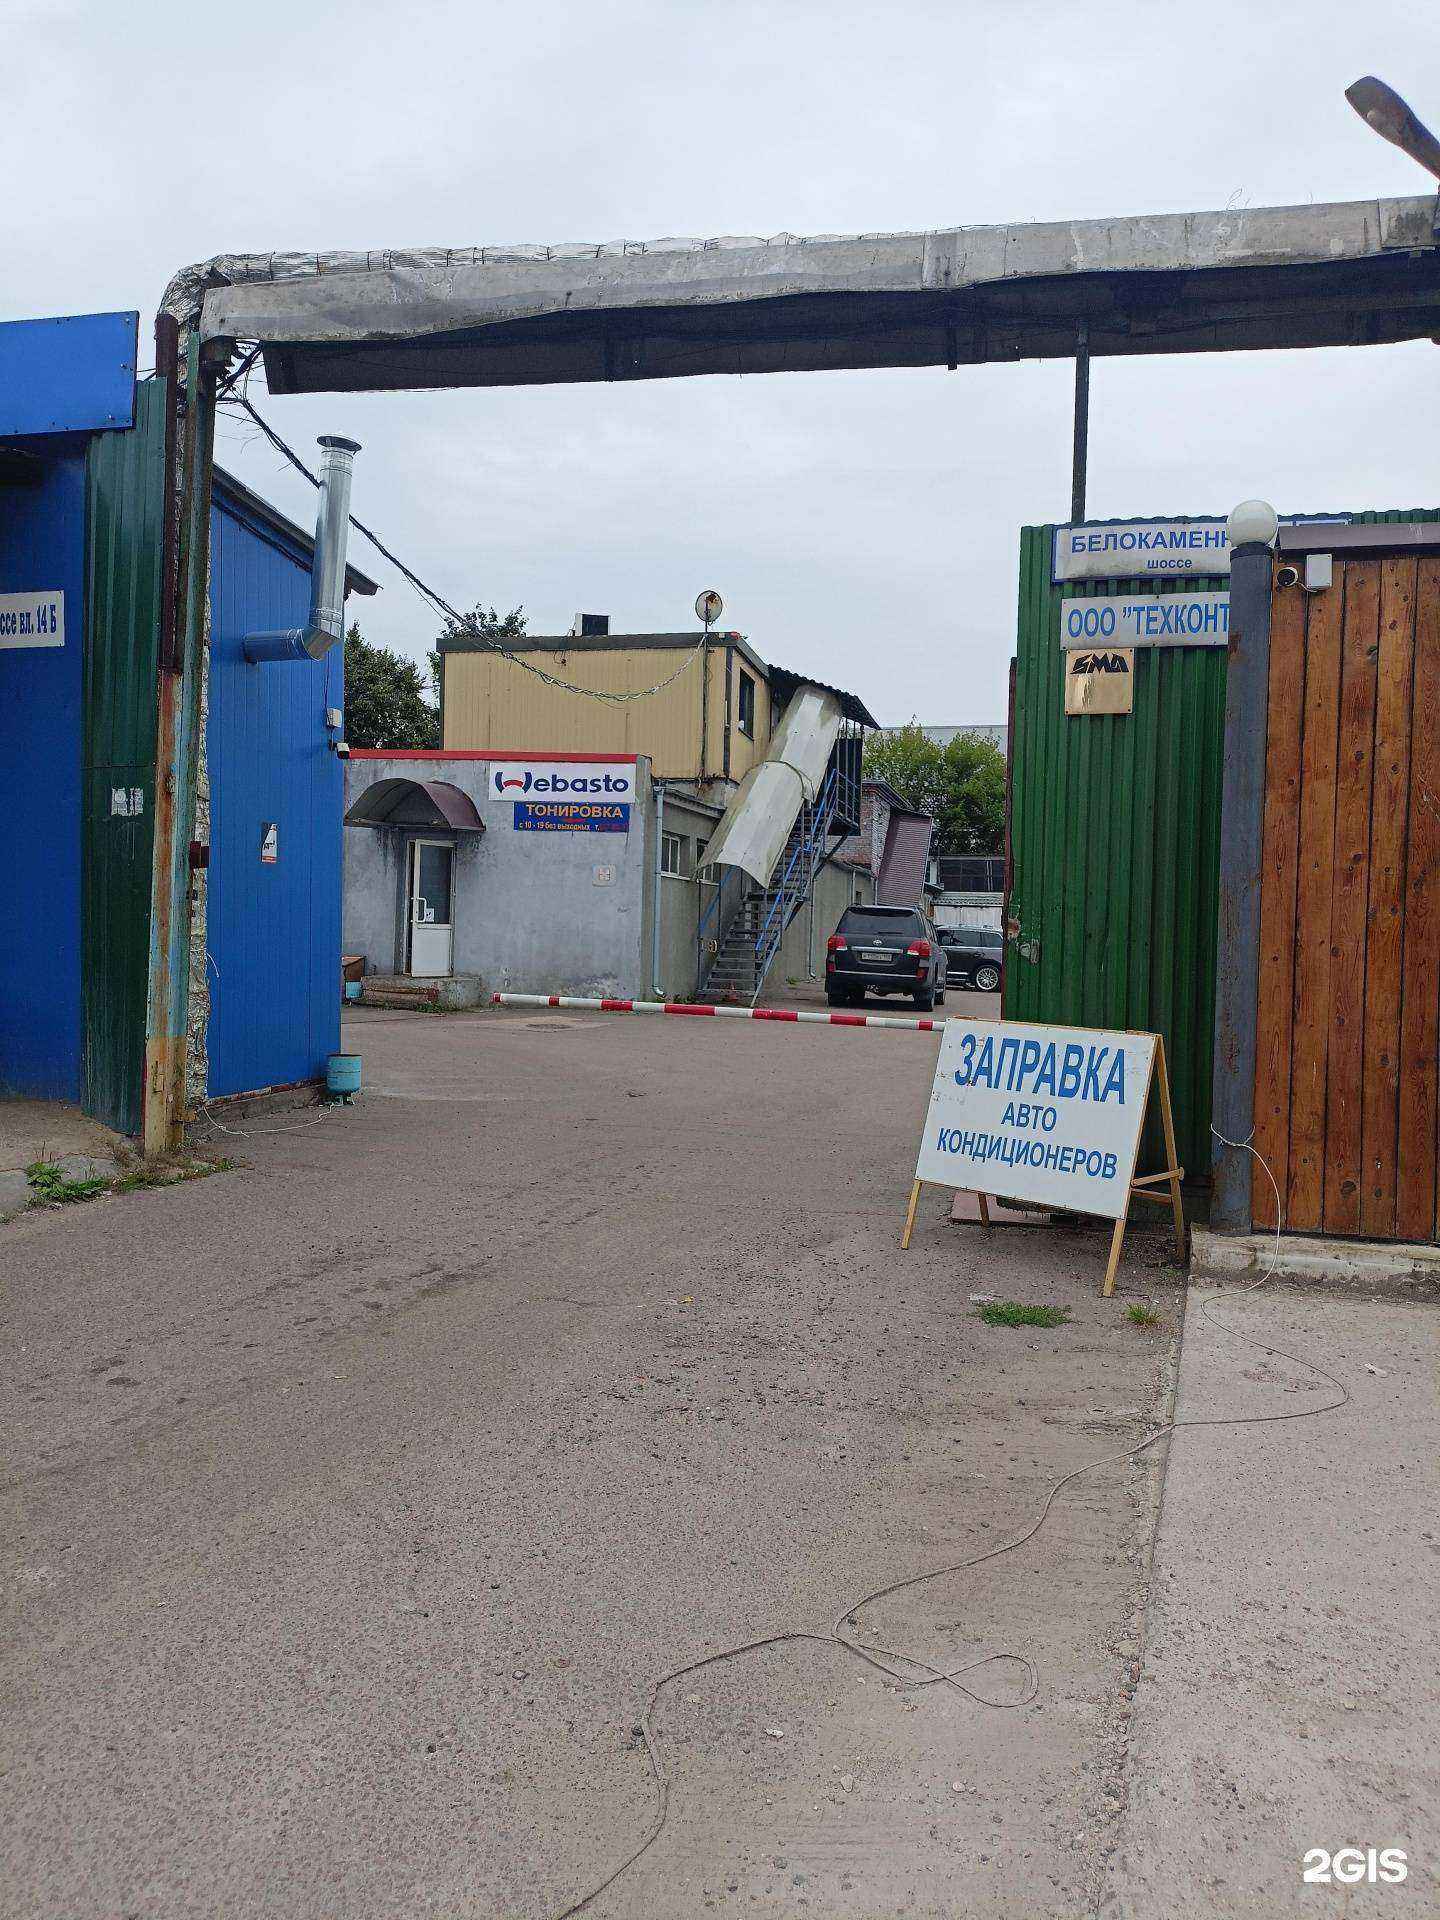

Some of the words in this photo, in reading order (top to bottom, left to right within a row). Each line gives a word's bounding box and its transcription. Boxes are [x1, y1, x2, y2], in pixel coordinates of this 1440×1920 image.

[1147, 558, 1193, 569] шоссе
[20, 612, 34, 635] вл.
[36, 604, 48, 634] 14
[49, 604, 57, 634] Б
[1068, 606, 1116, 639] ООО
[494, 771, 630, 794] Webasto
[525, 820, 532, 829] 10
[537, 821, 544, 829] 19
[526, 804, 624, 819] ТОНИРОВКА
[954, 1033, 1125, 1105] ЗАПРАВКА
[1000, 1102, 1057, 1132] АВТО
[936, 1127, 1119, 1179] КОНДИЦИОНЕРОВ
